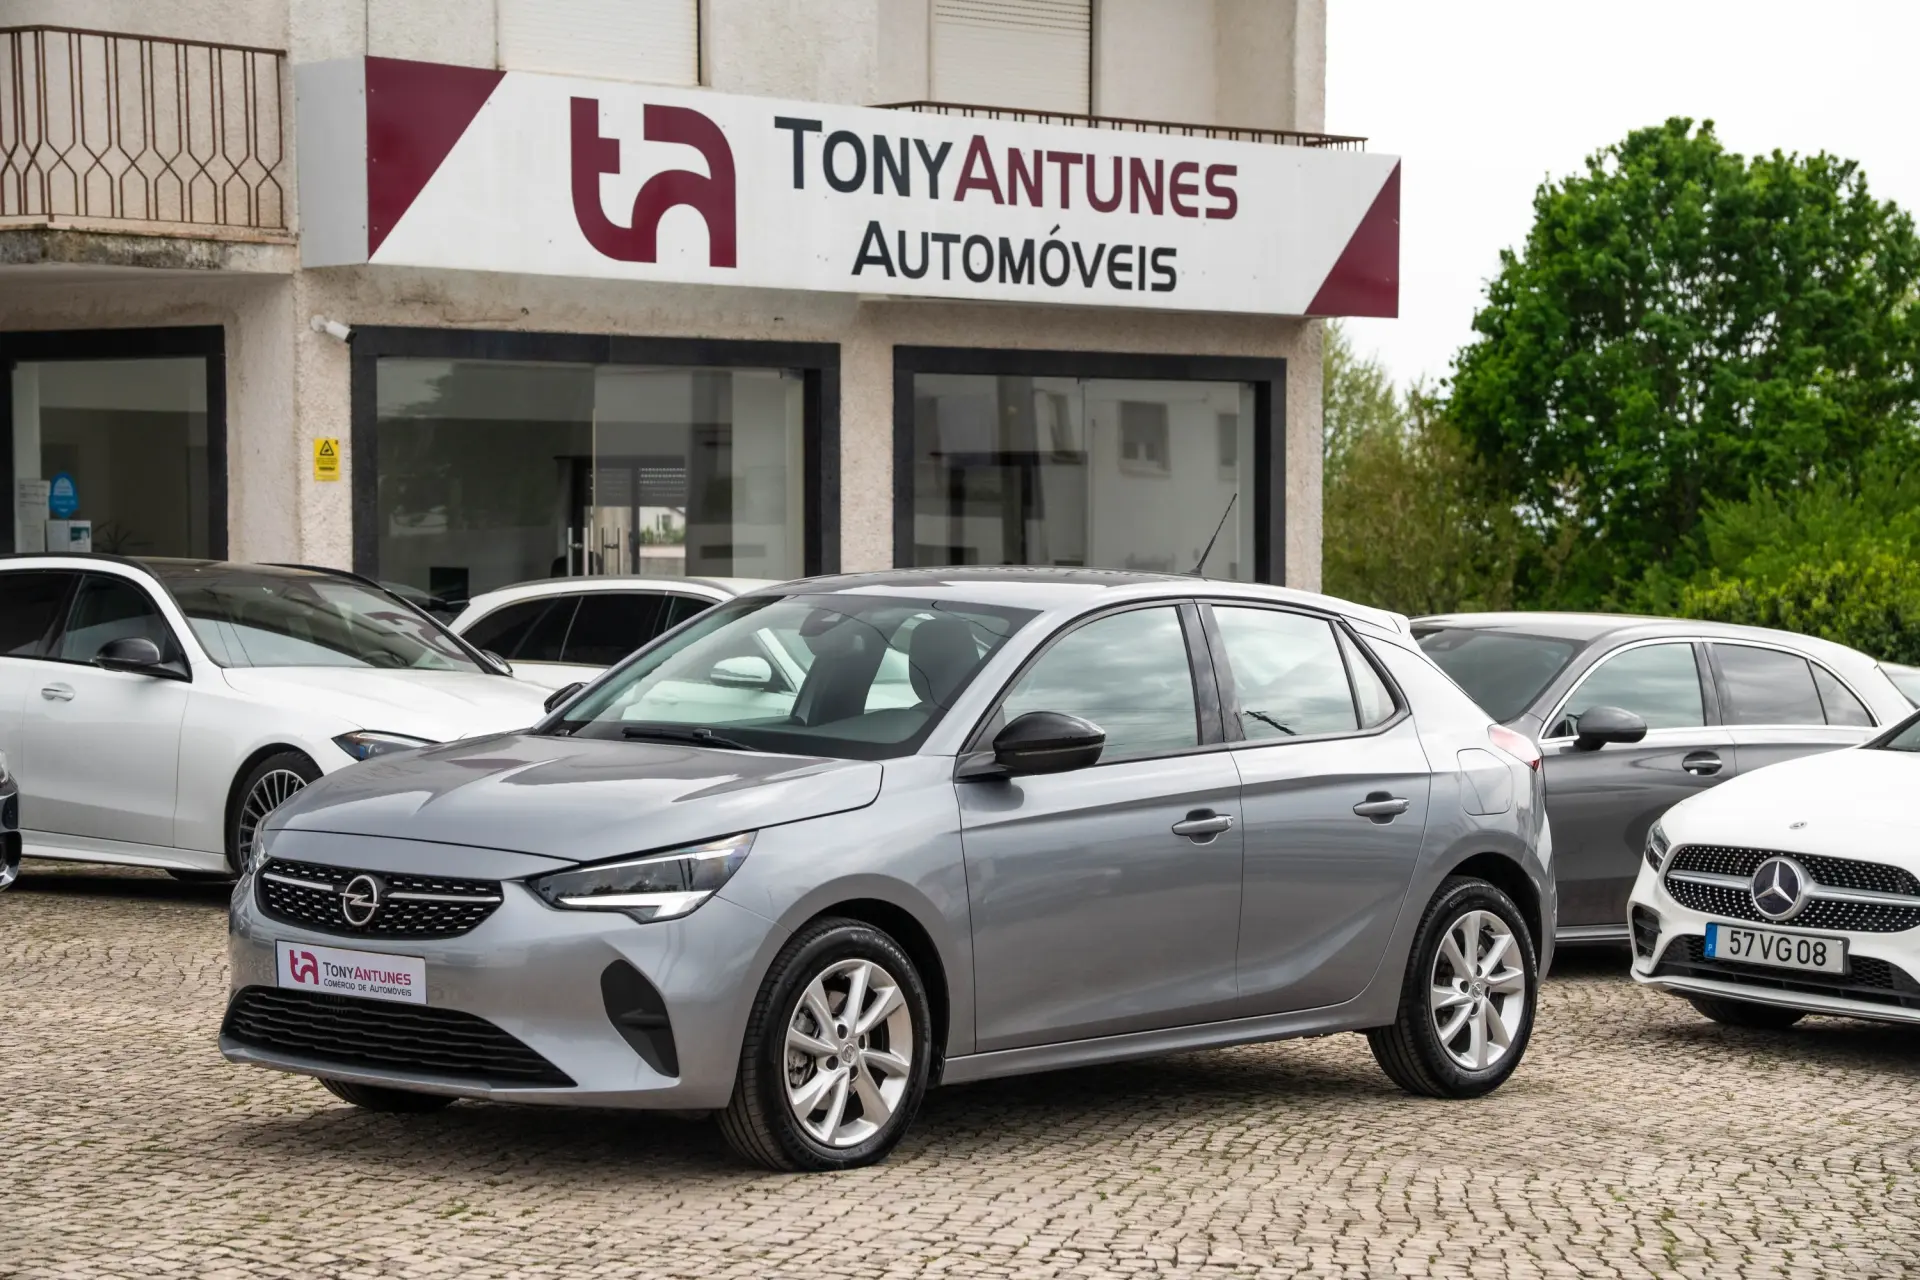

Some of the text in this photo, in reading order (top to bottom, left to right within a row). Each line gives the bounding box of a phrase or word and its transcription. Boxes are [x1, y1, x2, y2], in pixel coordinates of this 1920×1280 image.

[852, 220, 1177, 292] AUTOMÓVEIS
[323, 978, 412, 997] COMÉRCIO DE AUTOMÓVEIS
